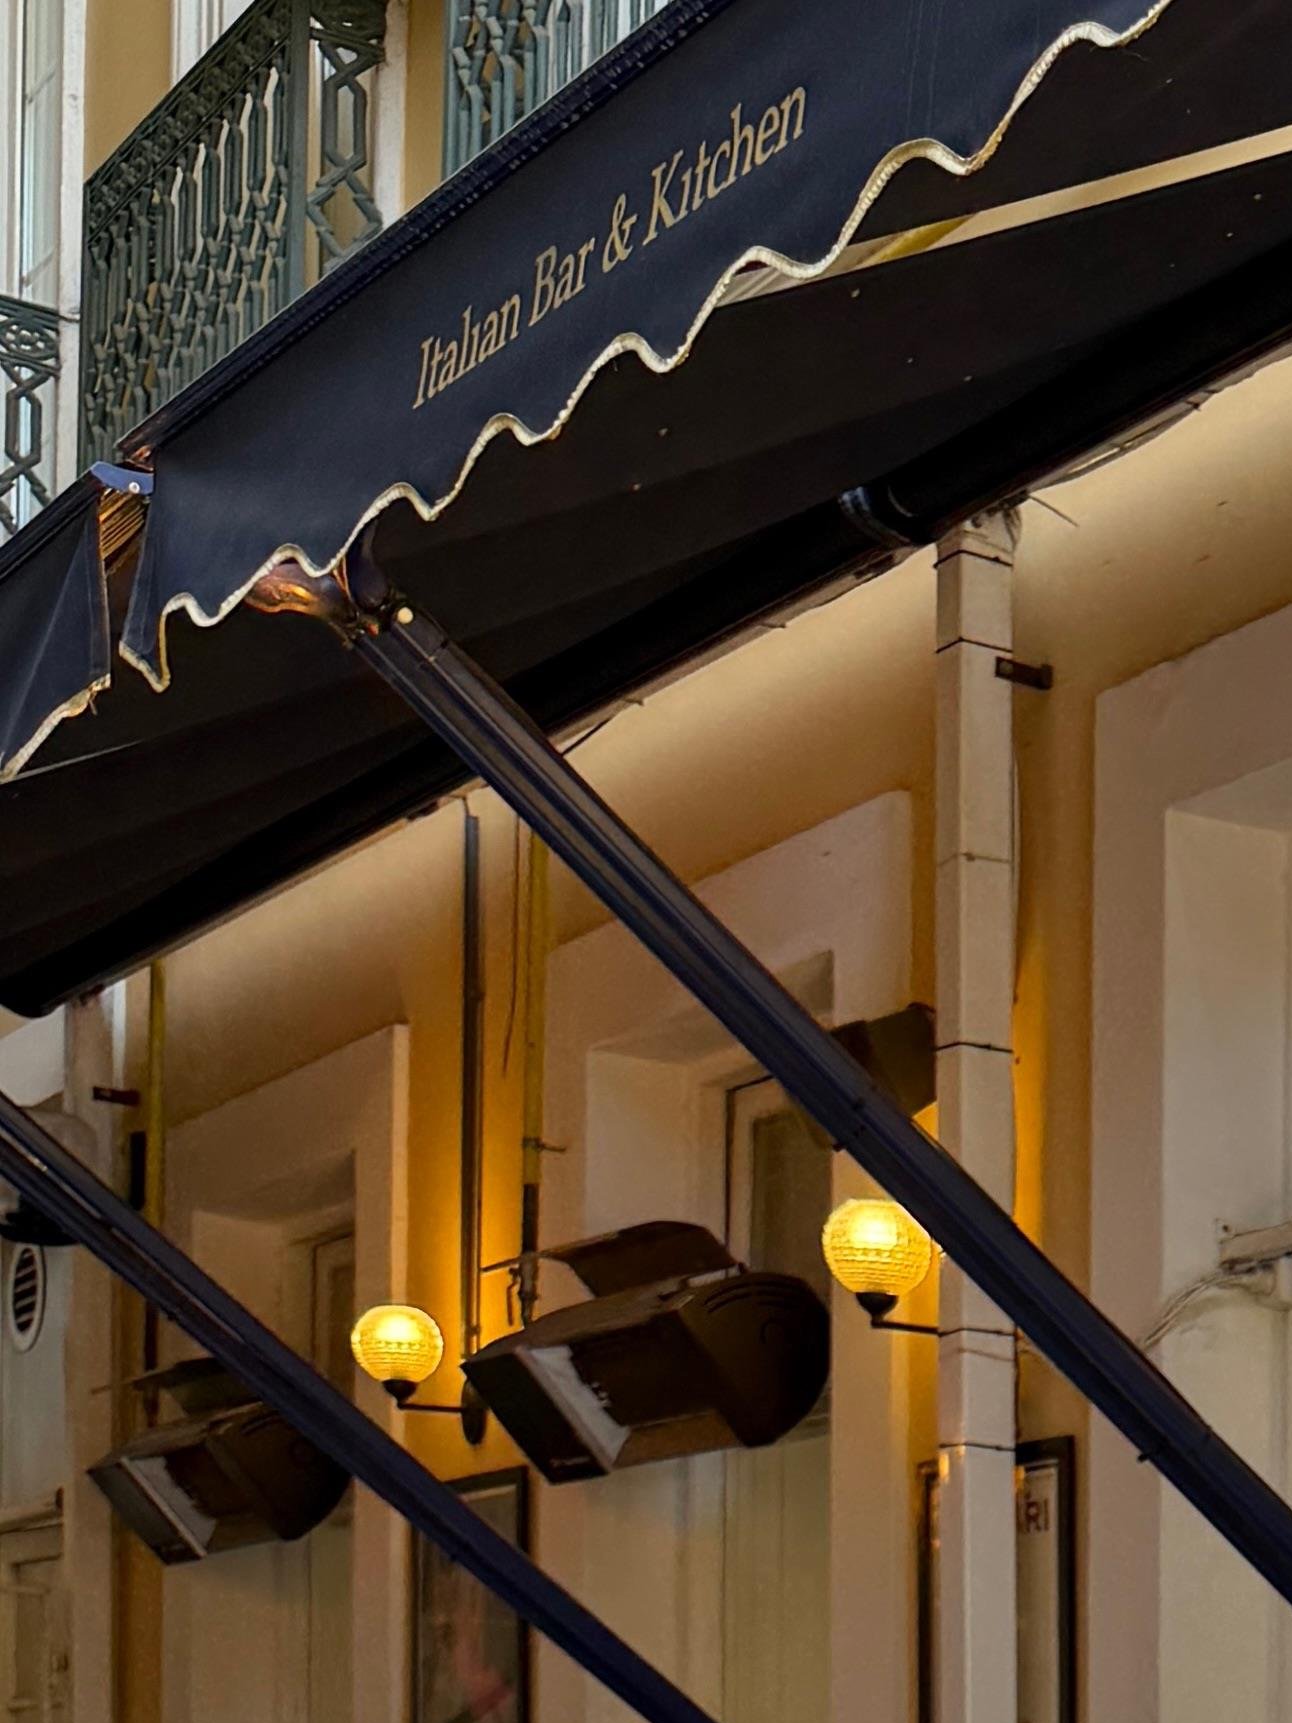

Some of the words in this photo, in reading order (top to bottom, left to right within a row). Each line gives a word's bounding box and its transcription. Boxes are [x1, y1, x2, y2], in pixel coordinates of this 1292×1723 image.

[412, 293, 520, 409] Italian
[528, 236, 595, 328] Bar
[602, 193, 636, 273] &
[642, 86, 808, 246] Kitchen
